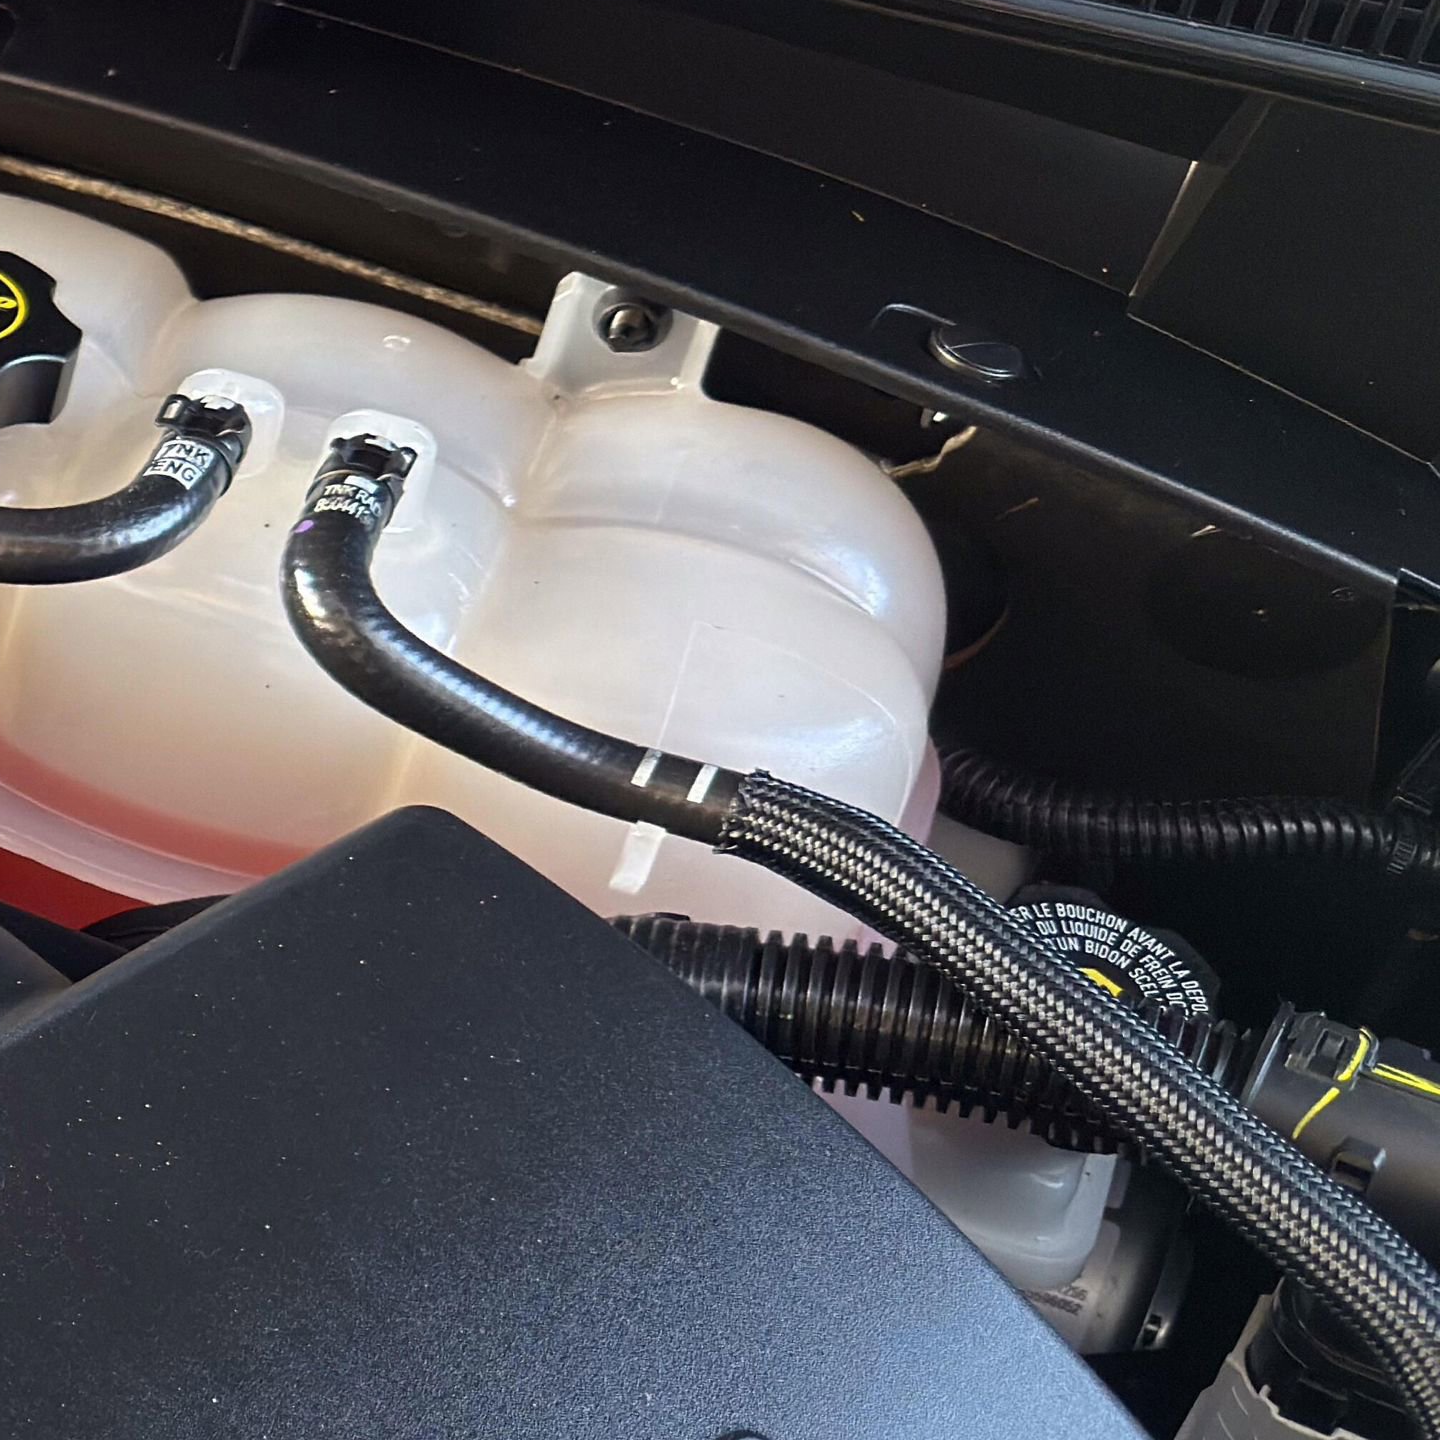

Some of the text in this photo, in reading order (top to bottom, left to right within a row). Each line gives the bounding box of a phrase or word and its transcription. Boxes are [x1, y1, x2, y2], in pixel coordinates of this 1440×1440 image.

[164, 441, 211, 468] TNK
[151, 460, 197, 483] ENG
[1032, 902, 1051, 918] LE
[1055, 902, 1128, 933] BOUCHON
[1127, 927, 1176, 960] AVANT
[1168, 961, 1191, 980] LA
[1036, 920, 1057, 936] DU
[1061, 920, 1119, 947] LIQUIDE
[1119, 938, 1142, 958] DE
[1139, 953, 1178, 990] FREIN
[1085, 939, 1131, 969] BIDON
